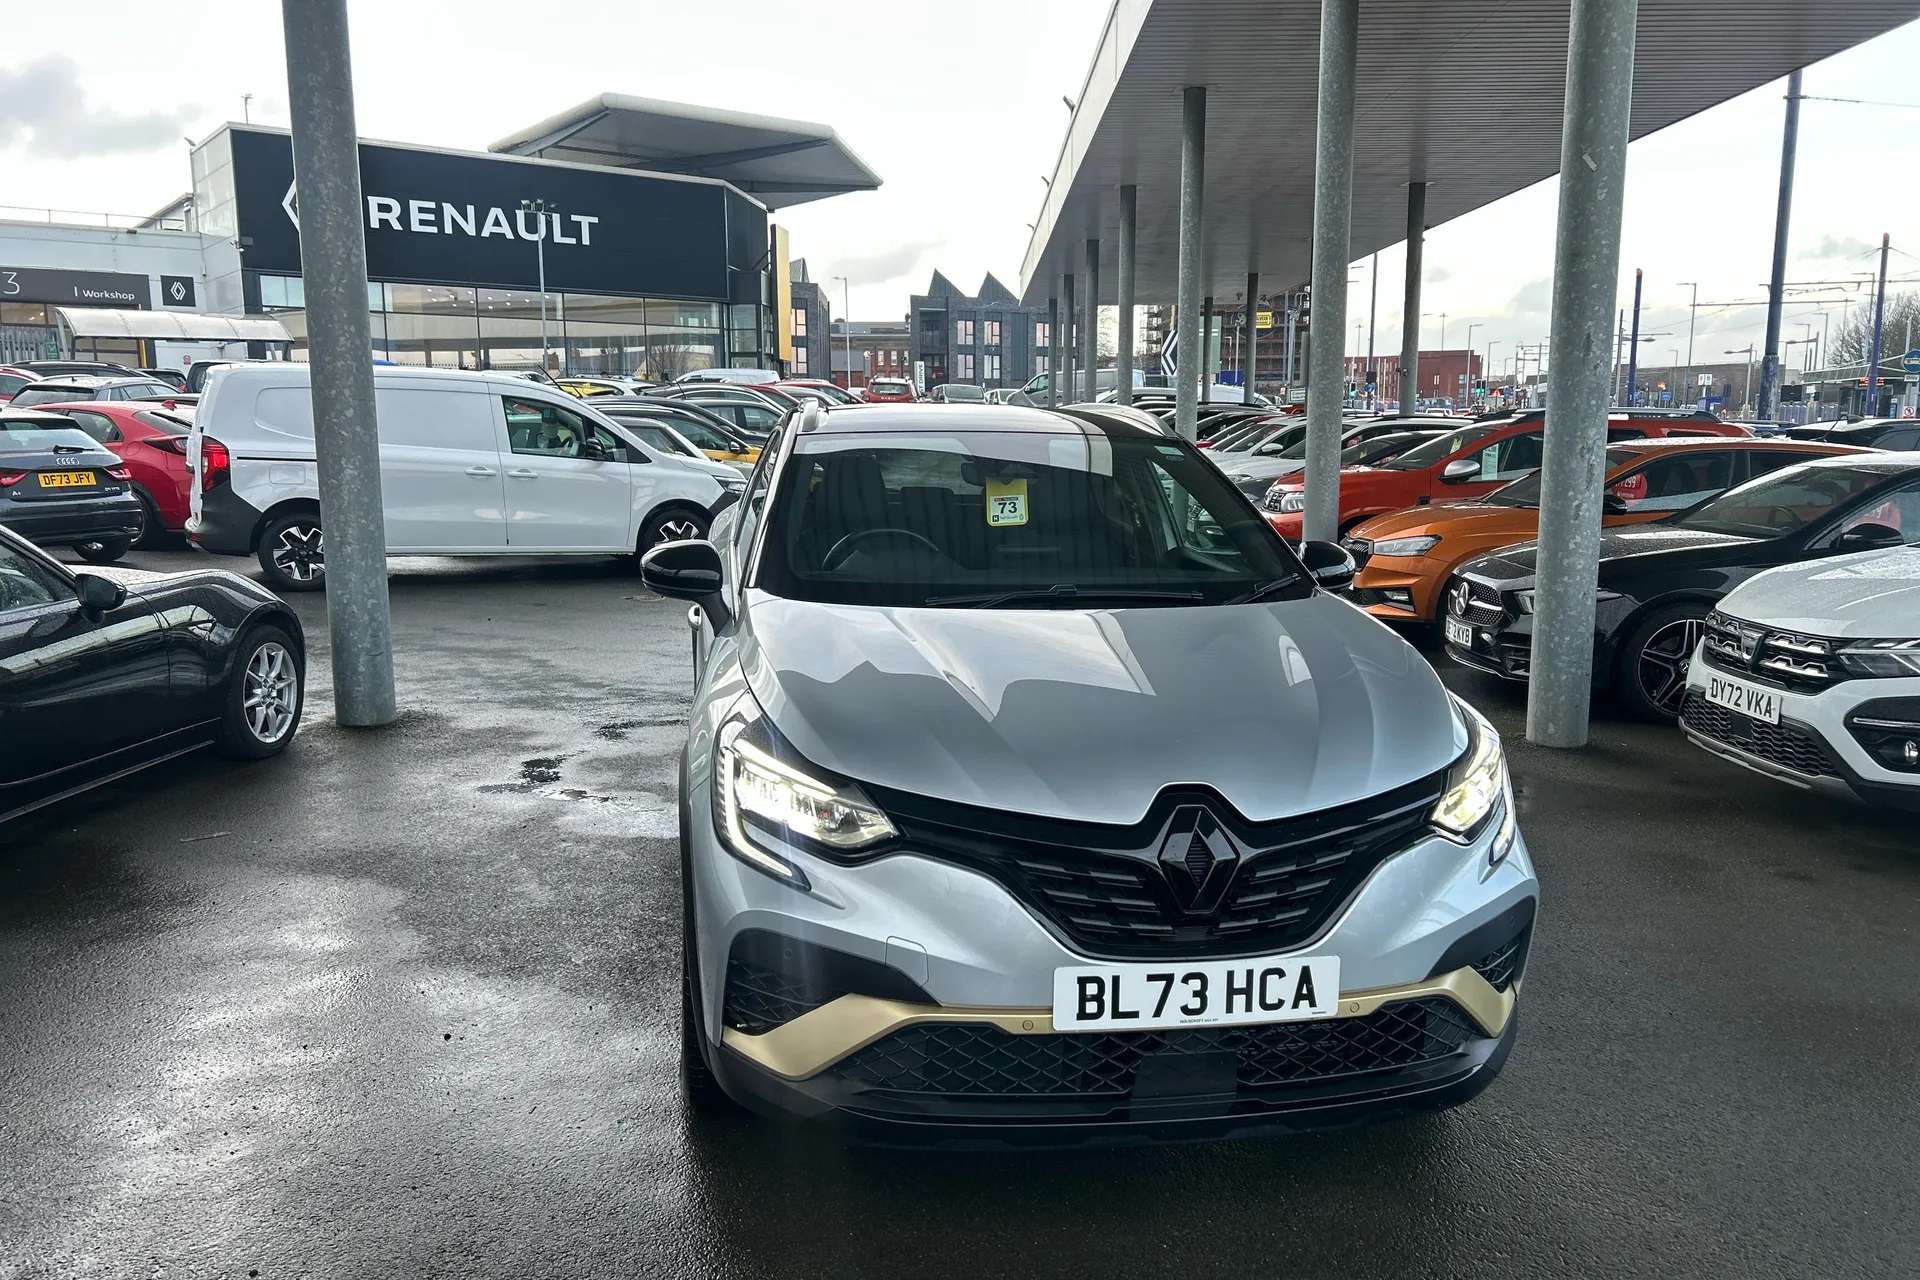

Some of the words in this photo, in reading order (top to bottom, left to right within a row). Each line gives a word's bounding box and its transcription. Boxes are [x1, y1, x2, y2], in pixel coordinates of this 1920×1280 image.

[367, 195, 599, 246] RENAULT
[2, 271, 20, 295] 3
[82, 289, 135, 301] Workshop
[43, 476, 70, 486] DF73
[74, 476, 91, 484] JFY
[998, 502, 1017, 514] 73
[1457, 625, 1470, 643] KYB
[1711, 677, 1742, 707] DY72
[1747, 689, 1772, 718] VKA
[1076, 971, 1208, 1021] BL73
[1225, 965, 1317, 1014] HCA
